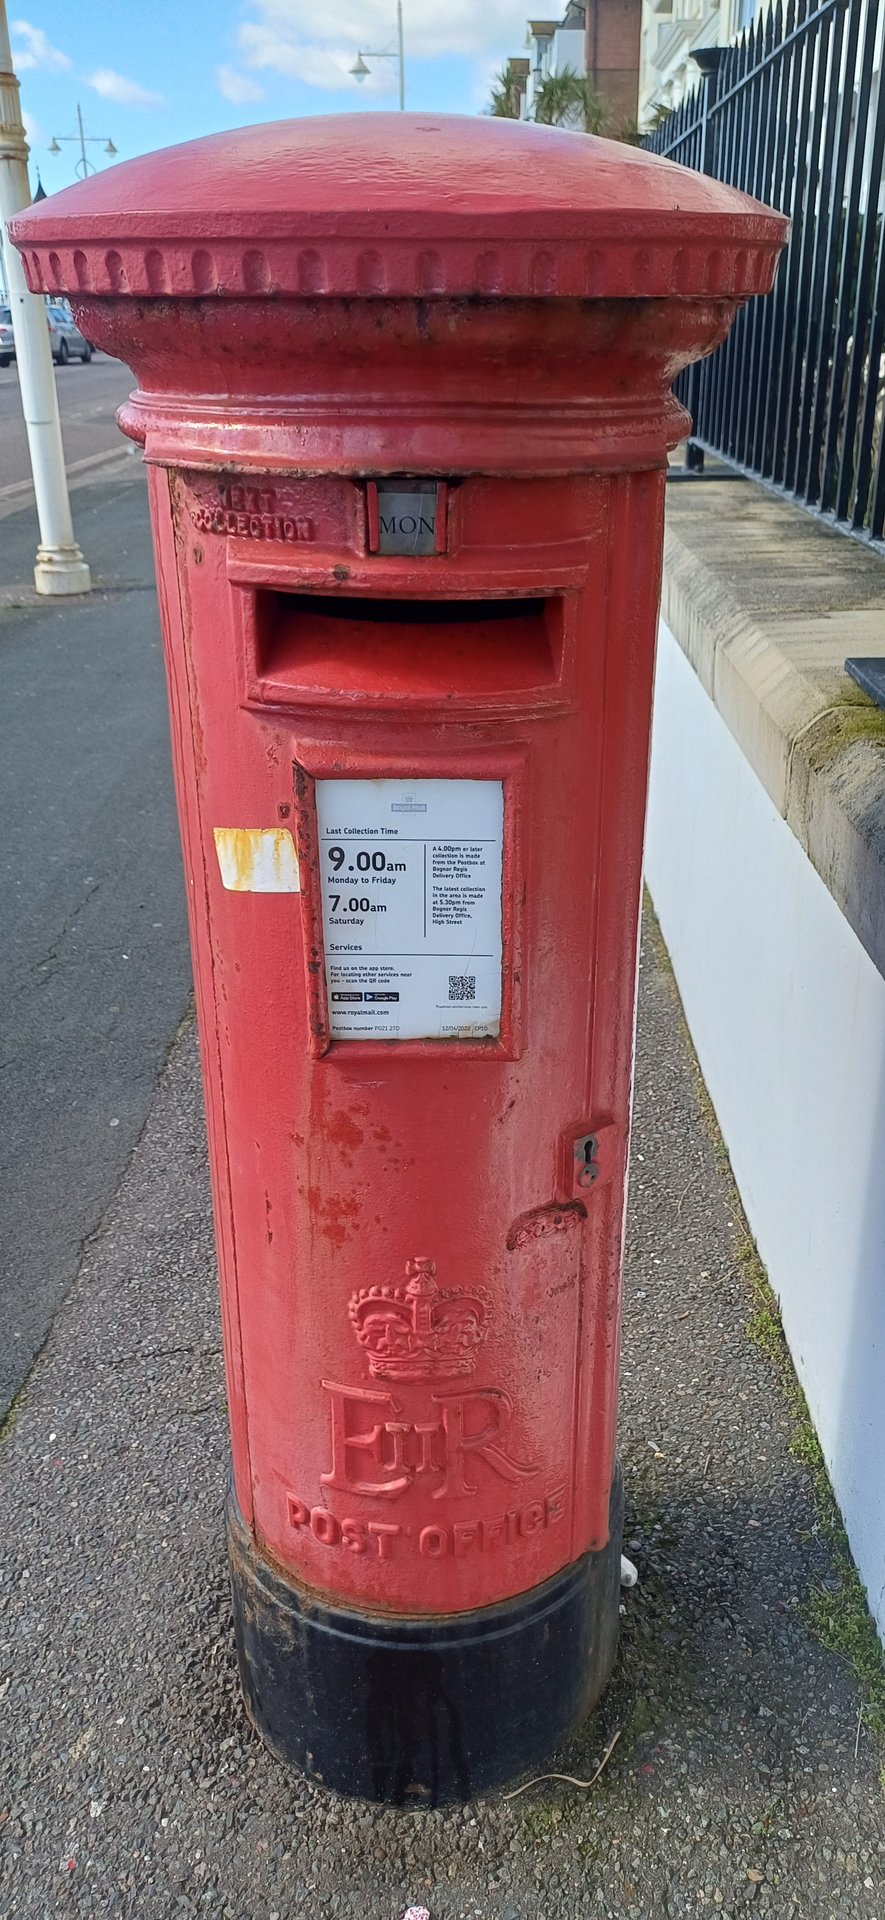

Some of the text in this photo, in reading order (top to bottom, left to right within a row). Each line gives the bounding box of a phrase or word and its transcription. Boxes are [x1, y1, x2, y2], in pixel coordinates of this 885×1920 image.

[191, 508, 316, 541] COLLECTION
[379, 516, 435, 534] MON
[328, 846, 406, 872] 9.00am
[328, 876, 358, 885] Monday
[372, 876, 396, 885] Friday
[328, 895, 387, 912] 7.00am
[329, 917, 364, 925] Saturday
[286, 1485, 566, 1559] POST OFFICE
